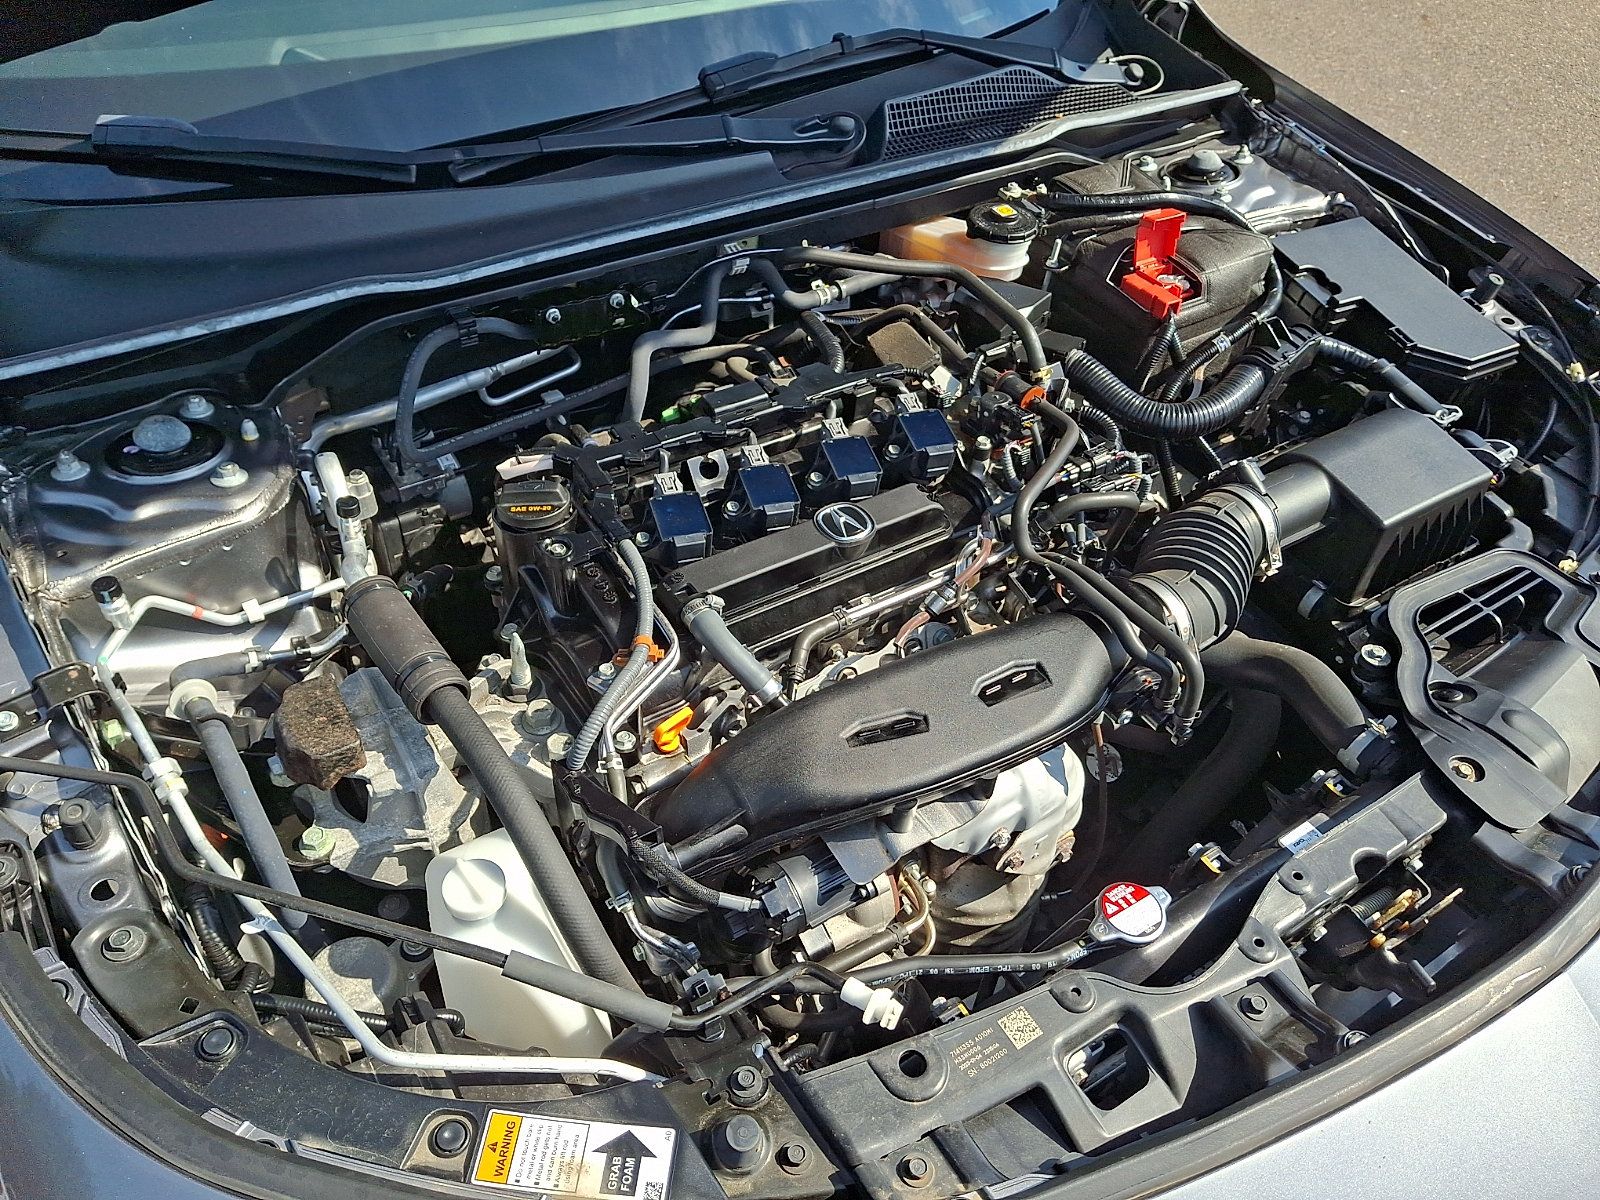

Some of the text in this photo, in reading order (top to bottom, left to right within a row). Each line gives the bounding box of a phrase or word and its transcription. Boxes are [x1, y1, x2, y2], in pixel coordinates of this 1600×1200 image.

[997, 964, 1012, 972] TPC
[494, 1121, 516, 1177] WARNING
[516, 1168, 523, 1178] Do
[535, 1163, 543, 1180] Metal
[608, 1157, 622, 1189] GRAB
[621, 1158, 635, 1191] FOAM
